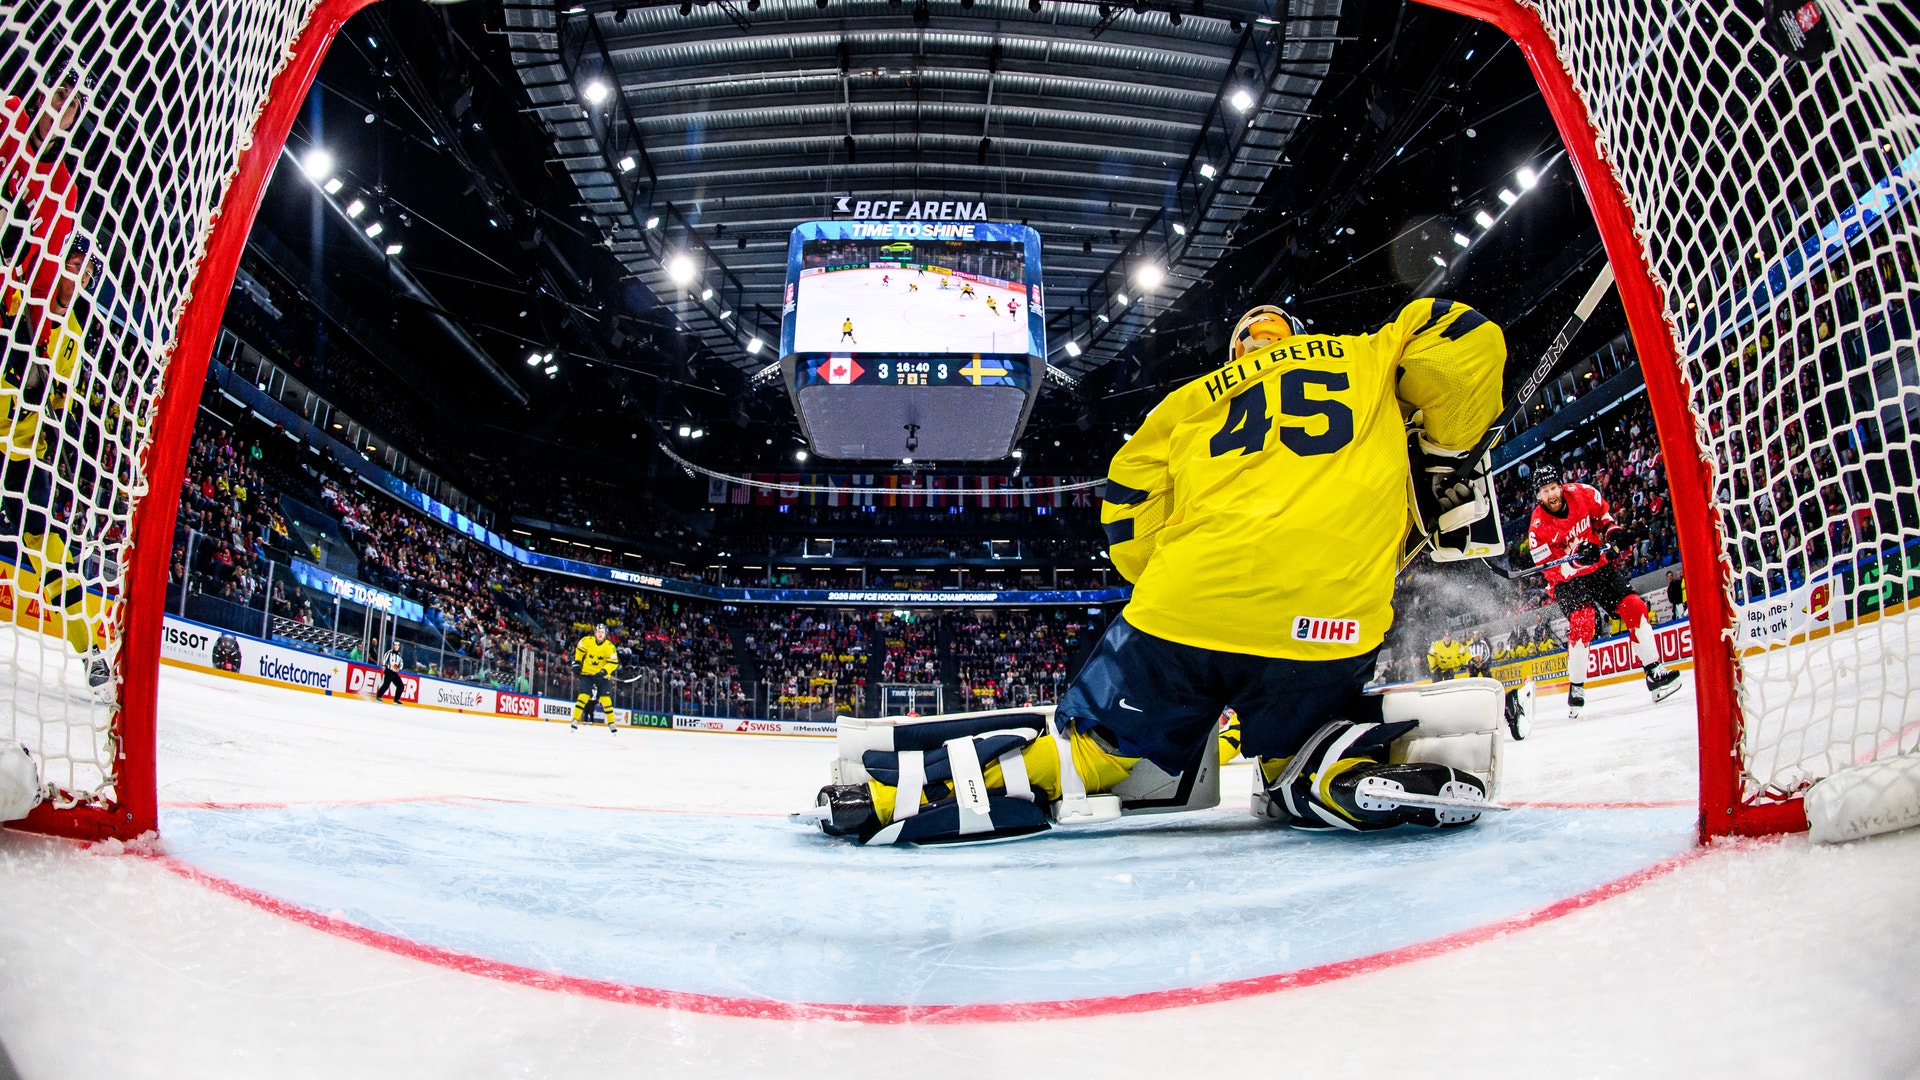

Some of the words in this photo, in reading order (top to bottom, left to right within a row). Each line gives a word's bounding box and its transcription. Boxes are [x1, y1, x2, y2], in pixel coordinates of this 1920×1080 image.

[854, 200, 904, 220] BCF
[905, 200, 988, 221] ARENA
[852, 223, 895, 237] TIME
[897, 223, 921, 237] TO
[922, 224, 976, 238] SHINE
[64, 338, 75, 361] A
[878, 363, 889, 379] 3
[896, 362, 930, 373] 16:40
[937, 363, 948, 379] 3
[1517, 332, 1570, 404] CCM
[1210, 368, 1354, 458] 45
[1564, 514, 1591, 546] ANADA
[611, 569, 629, 581] TIME
[629, 573, 640, 583] TO
[640, 575, 663, 587] SHINE
[331, 576, 354, 598] TIME
[354, 585, 367, 602] TO
[367, 590, 393, 611] SHINE
[828, 592, 849, 601] 2026
[864, 592, 878, 601] ICE
[878, 593, 911, 601] HOCKEY
[910, 593, 939, 602] WORLD
[938, 593, 998, 602] CHAMPIONSHIP
[162, 626, 209, 651] ISSOT
[1311, 620, 1356, 640] IIHF
[1750, 626, 1761, 638] at
[1587, 629, 1693, 673] BAUUS
[259, 654, 332, 689] ticketcorner
[349, 667, 418, 699] DENER
[500, 695, 519, 714] SRG
[519, 697, 535, 716] SSR
[543, 704, 572, 717] LIEBHERR
[676, 717, 701, 728] IIHF
[750, 723, 782, 732] SWISS
[968, 779, 979, 804] CCM
